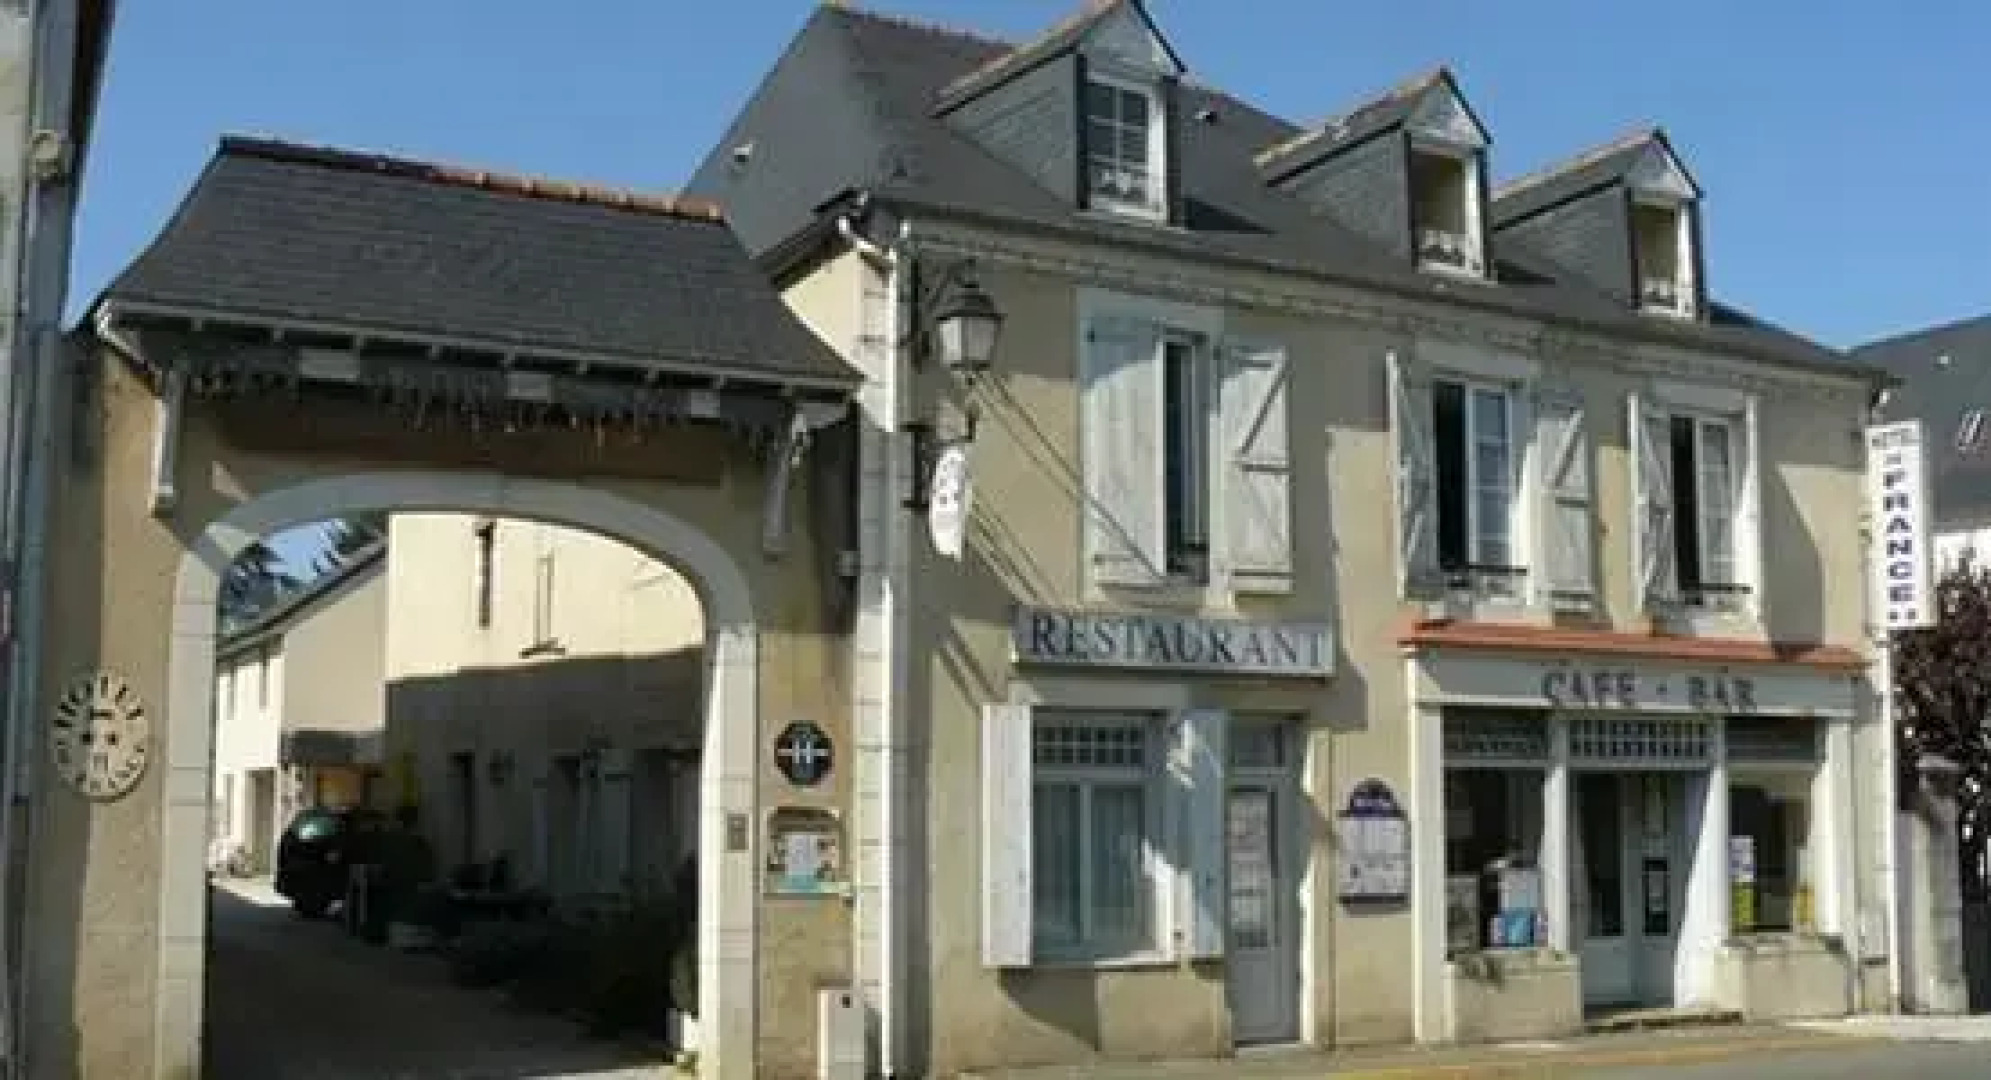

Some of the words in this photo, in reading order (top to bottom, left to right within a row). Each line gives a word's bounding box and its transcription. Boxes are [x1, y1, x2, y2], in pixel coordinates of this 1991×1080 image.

[1883, 471, 1914, 604] FRANCE
[1031, 612, 1330, 667] RESTAURANT
[1687, 675, 1757, 712] BAR
